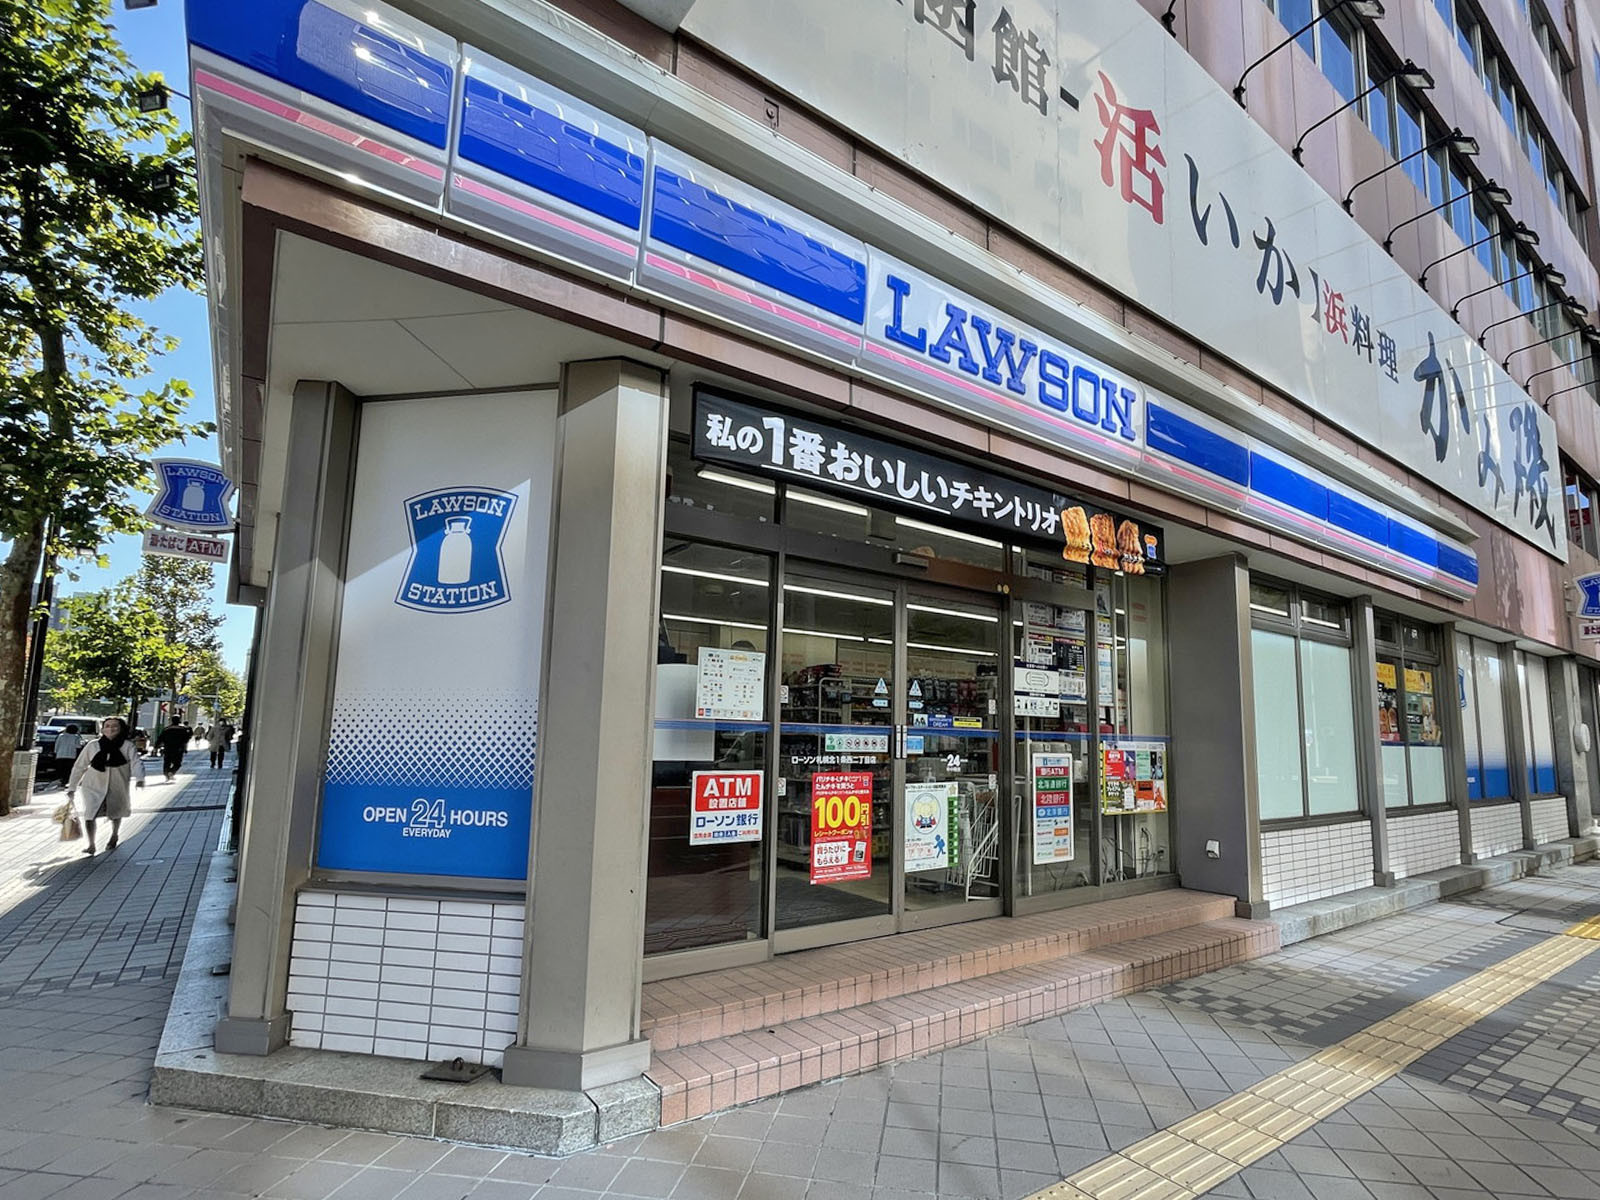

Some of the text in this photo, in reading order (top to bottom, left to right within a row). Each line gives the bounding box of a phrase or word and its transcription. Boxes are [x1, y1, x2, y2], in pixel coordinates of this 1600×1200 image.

[885, 274, 1137, 441] LAWSON
[166, 467, 228, 485] LAWSON
[159, 504, 221, 522] STATION
[414, 495, 506, 520] LAWSON
[189, 540, 222, 555] ATM
[407, 581, 498, 604] STATION
[947, 754, 961, 767] 24
[703, 778, 752, 798] ATM
[363, 798, 509, 829] OPEN 24 HOURS
[696, 813, 759, 828] ローソン銀行
[814, 796, 861, 829] 100
[402, 827, 452, 839] EVERYDAY
